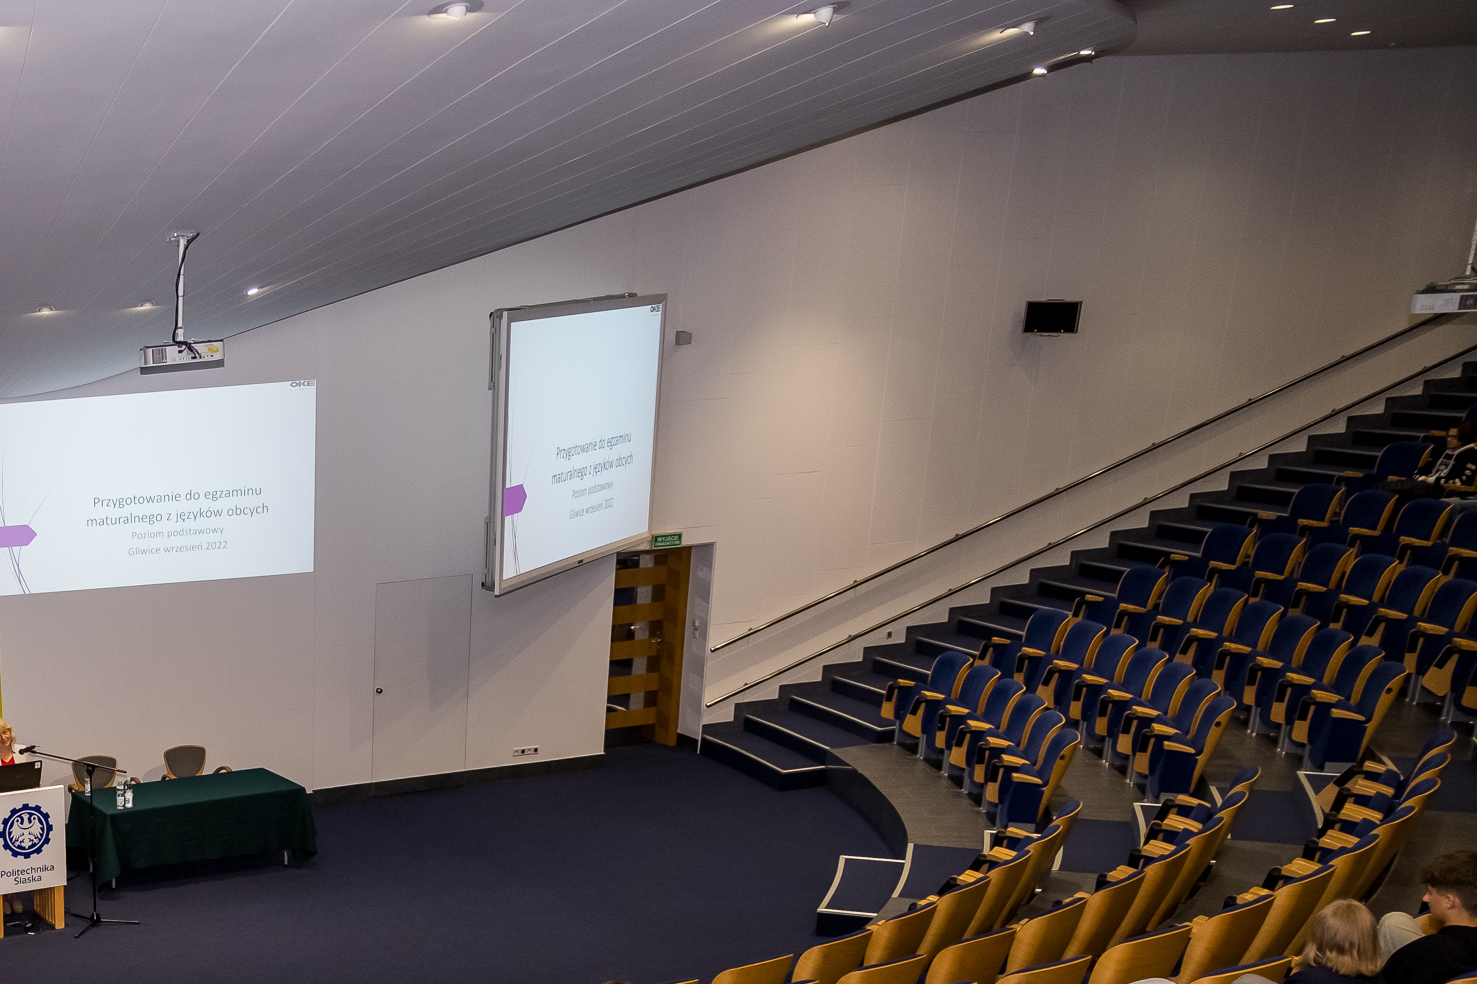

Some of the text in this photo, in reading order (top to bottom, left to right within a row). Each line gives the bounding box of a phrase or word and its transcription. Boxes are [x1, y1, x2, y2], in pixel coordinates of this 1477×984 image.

[556, 431, 632, 461] Przygotowanie do egzaminu
[552, 466, 587, 485] maturalnego
[615, 451, 633, 469] obcych
[93, 486, 262, 509] Przygotowanie do egzaminu
[86, 503, 269, 528] maturalnego z języków obcych
[131, 527, 224, 540] Poziom podstawowy
[128, 540, 228, 556] Gliwice wrzesień 2022
[0, 864, 54, 878] Politechnika
[14, 875, 42, 885] Śląska
